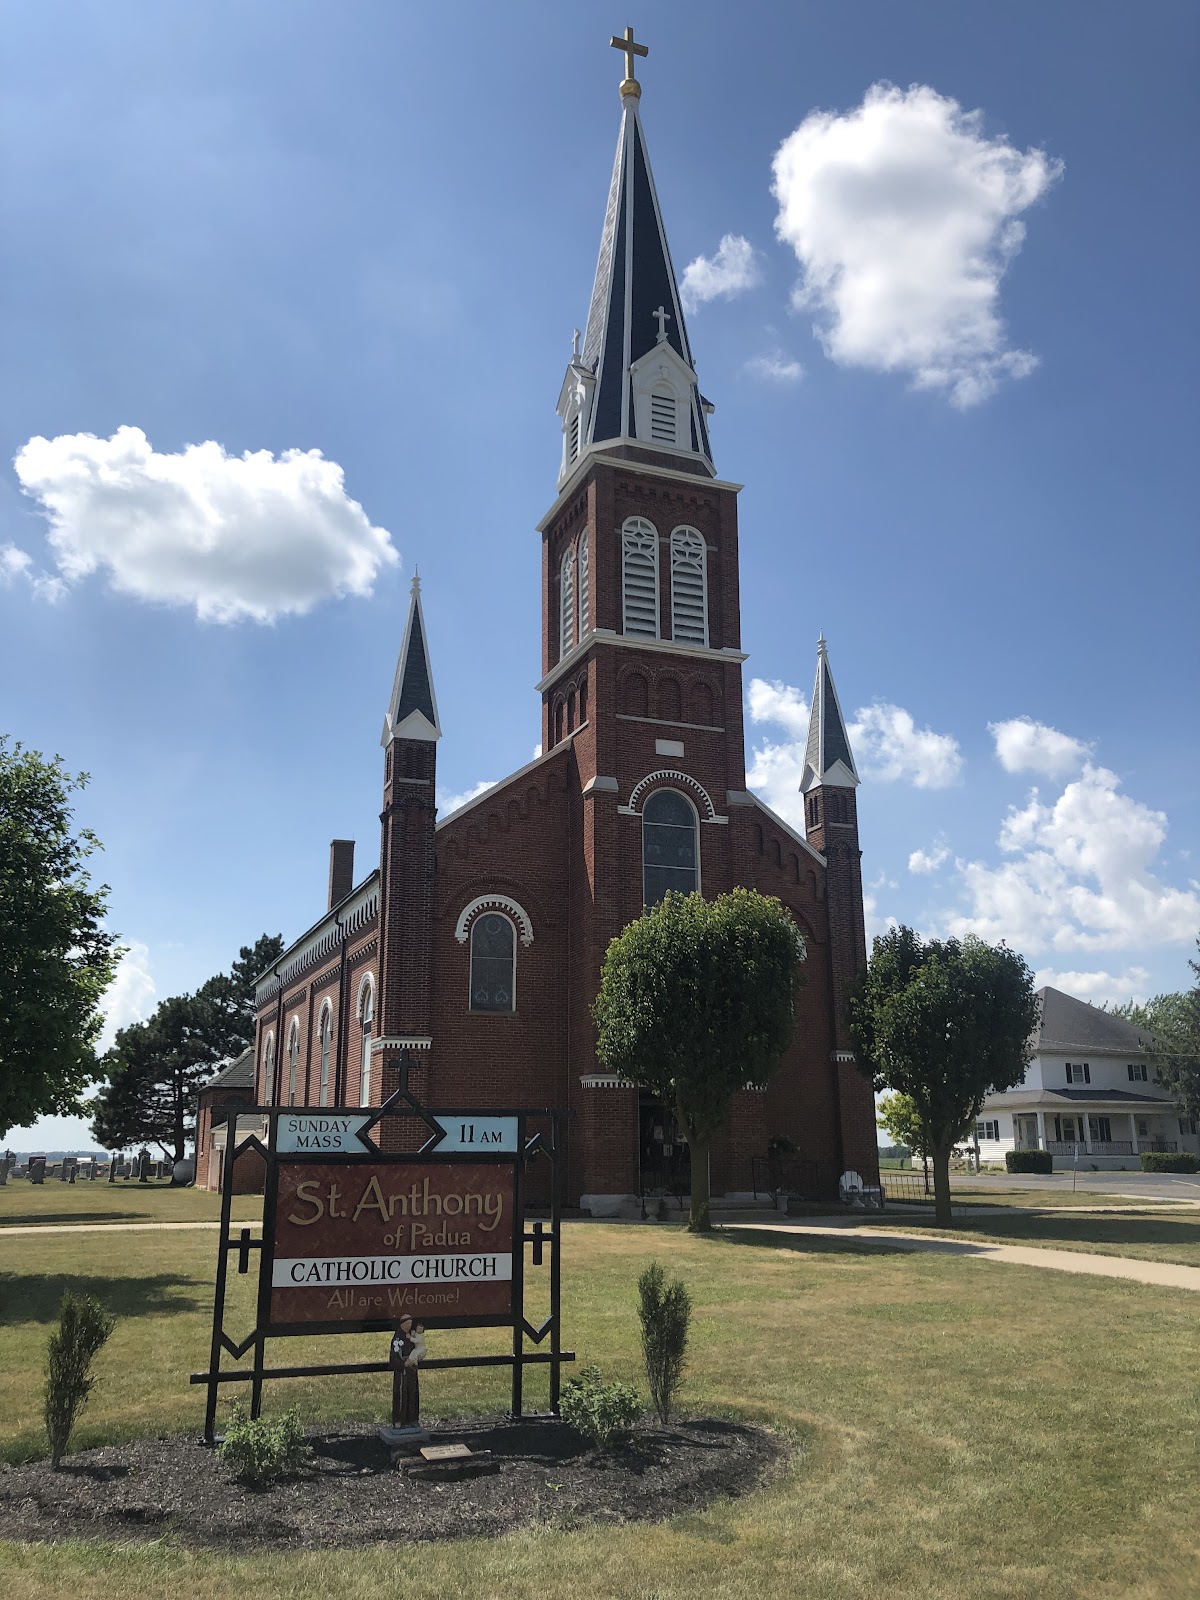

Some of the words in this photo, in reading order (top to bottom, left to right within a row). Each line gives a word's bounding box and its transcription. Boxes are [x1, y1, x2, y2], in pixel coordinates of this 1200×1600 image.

[288, 1119, 352, 1133] SUNDAY
[459, 1124, 475, 1143] 11
[480, 1132, 502, 1143] AM
[296, 1135, 342, 1148] MASS
[288, 1181, 346, 1225] St.
[352, 1174, 503, 1231] Anthony
[383, 1225, 404, 1250] of
[410, 1223, 471, 1251] Padua
[290, 1260, 401, 1283] CATHOLIC
[411, 1257, 497, 1279] CHURCH
[326, 1289, 354, 1309] All
[358, 1294, 382, 1307] are
[387, 1289, 460, 1308] Welcome!
